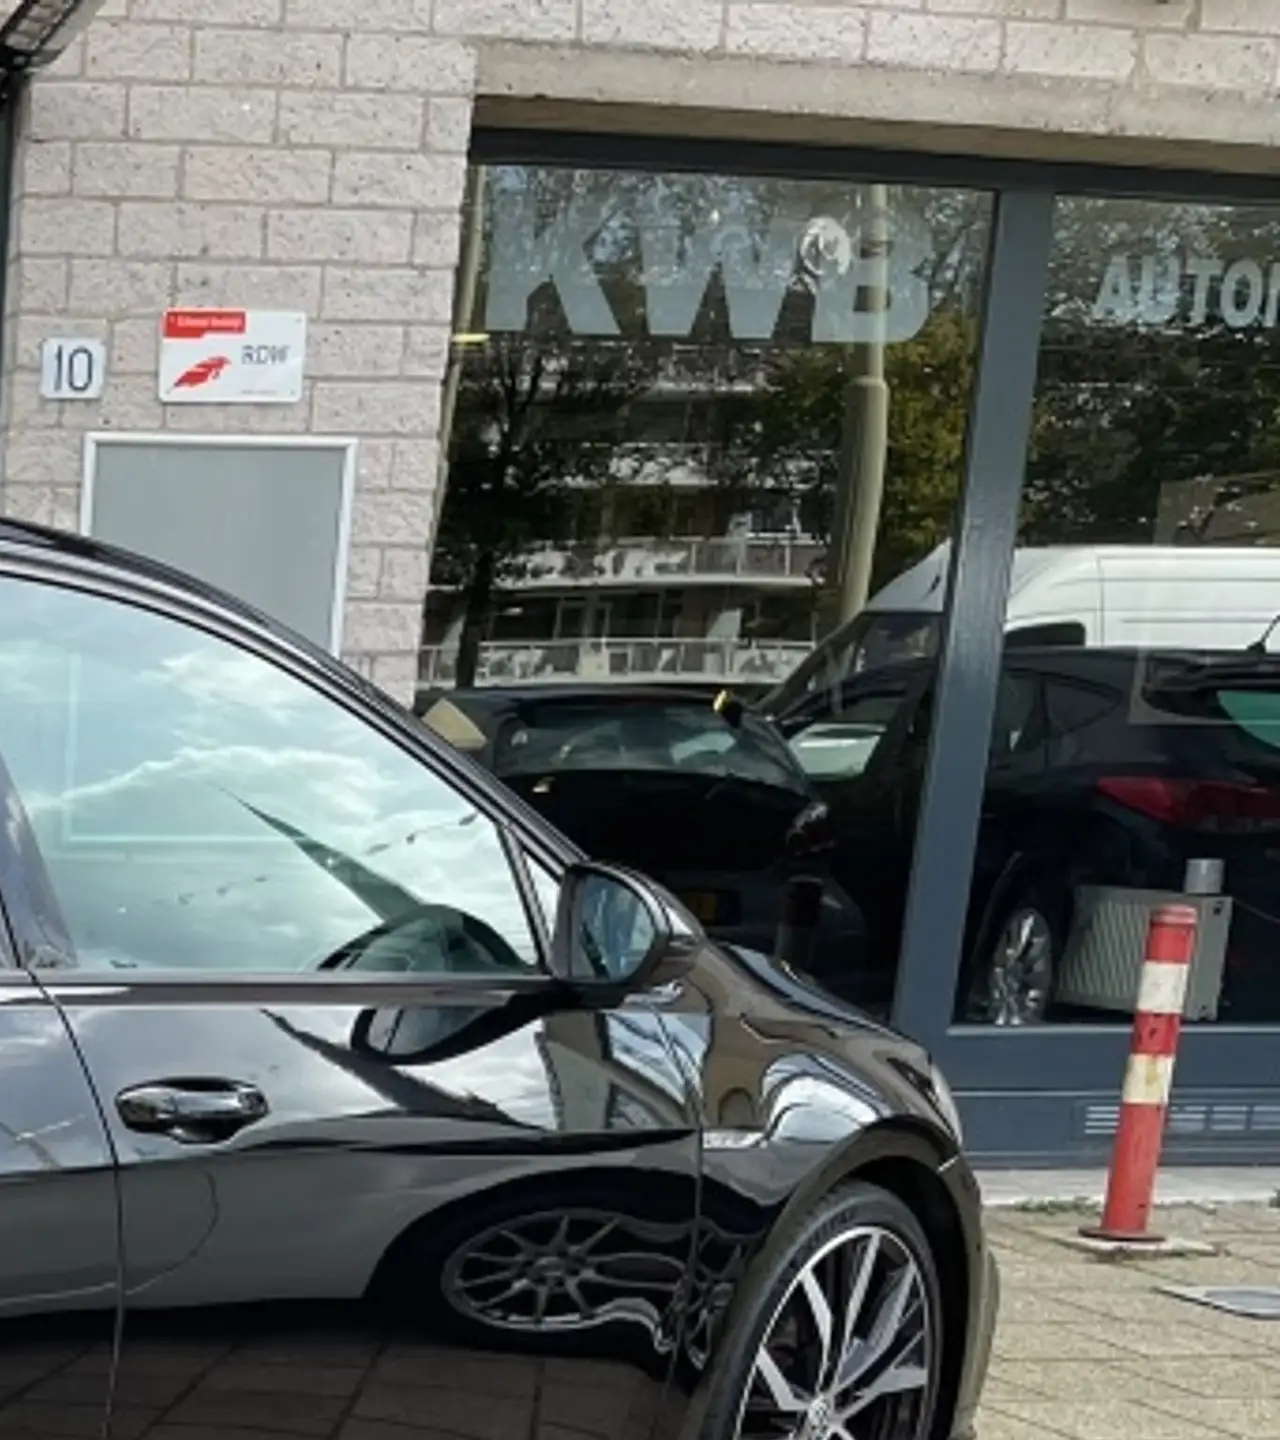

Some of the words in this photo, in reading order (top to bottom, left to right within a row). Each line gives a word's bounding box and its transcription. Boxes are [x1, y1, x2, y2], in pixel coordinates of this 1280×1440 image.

[485, 182, 932, 343] KWB
[1092, 253, 1280, 328] AUTO
[53, 345, 93, 392] 10
